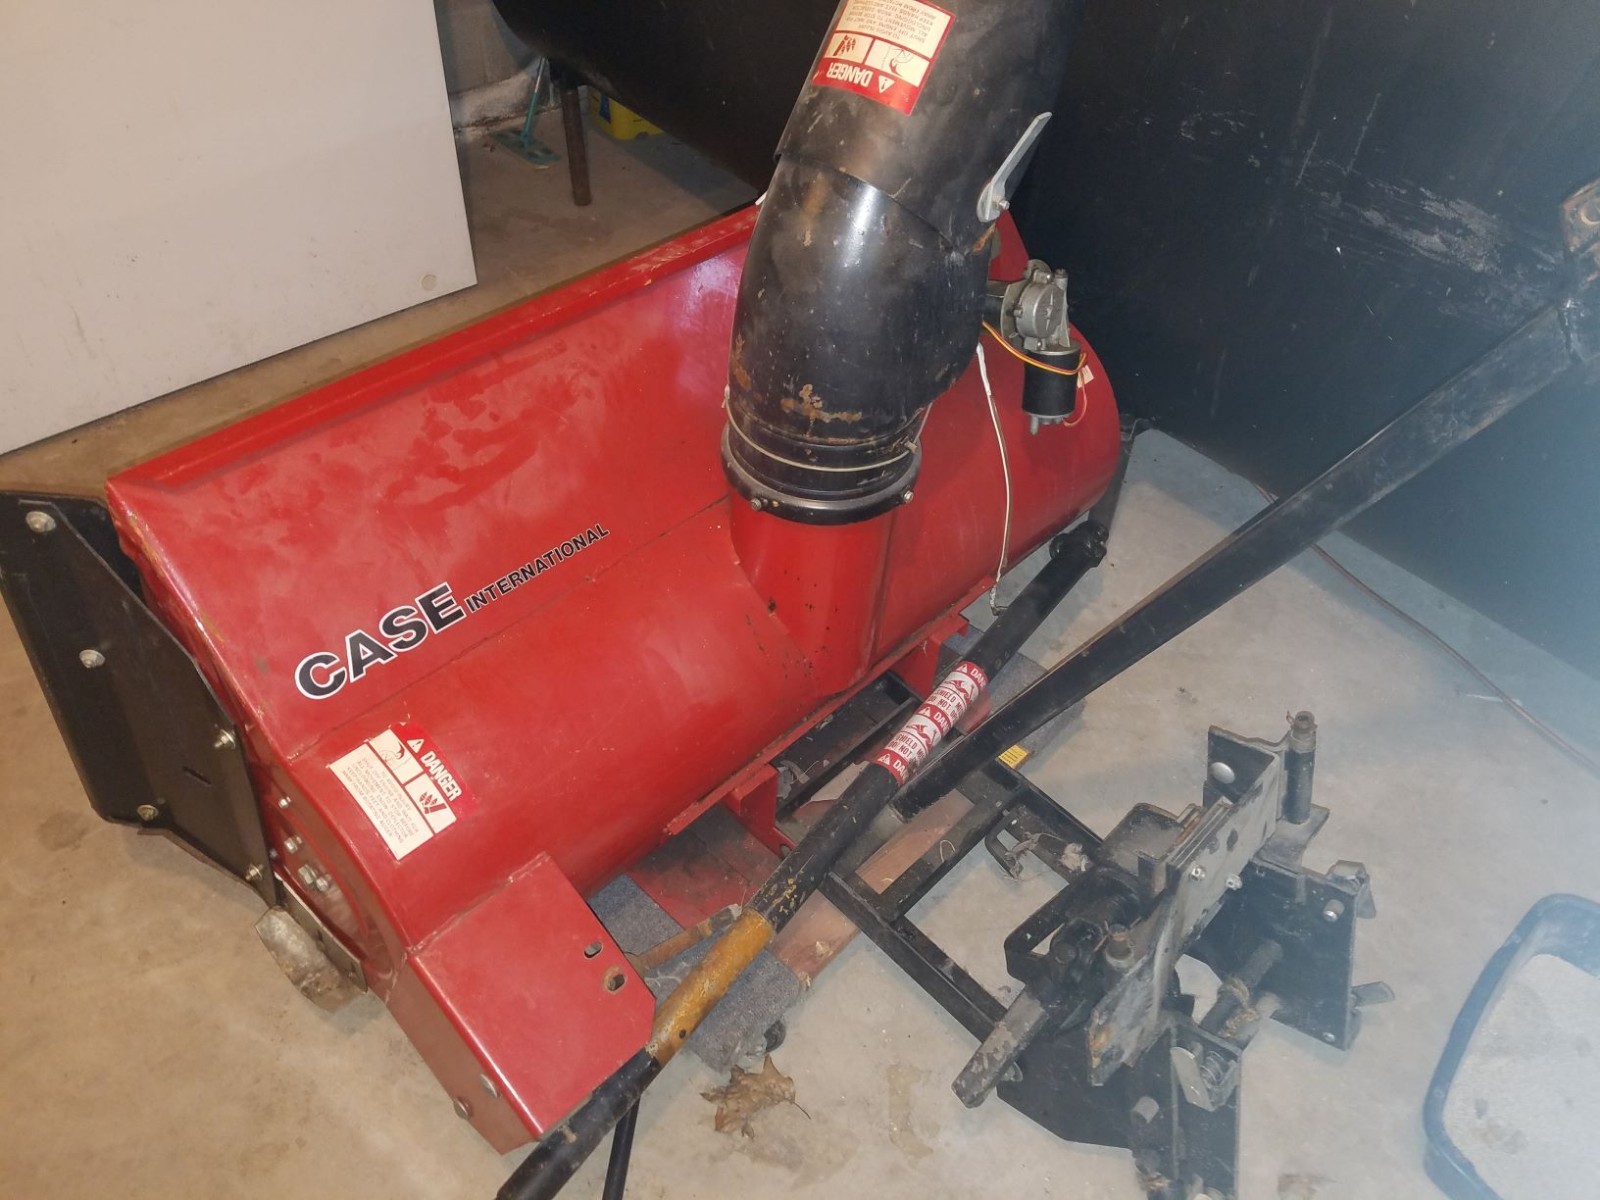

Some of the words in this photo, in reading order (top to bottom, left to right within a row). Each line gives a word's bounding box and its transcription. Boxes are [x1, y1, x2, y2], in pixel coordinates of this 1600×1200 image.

[826, 62, 873, 87] DANGER
[294, 581, 465, 700] CASE
[463, 523, 610, 613] INTERNATIONAL
[936, 689, 957, 703] SHIELD
[938, 700, 951, 711] NOT
[896, 734, 917, 749] SHIELD
[898, 746, 913, 757] NOT
[420, 751, 463, 801] DANGER
